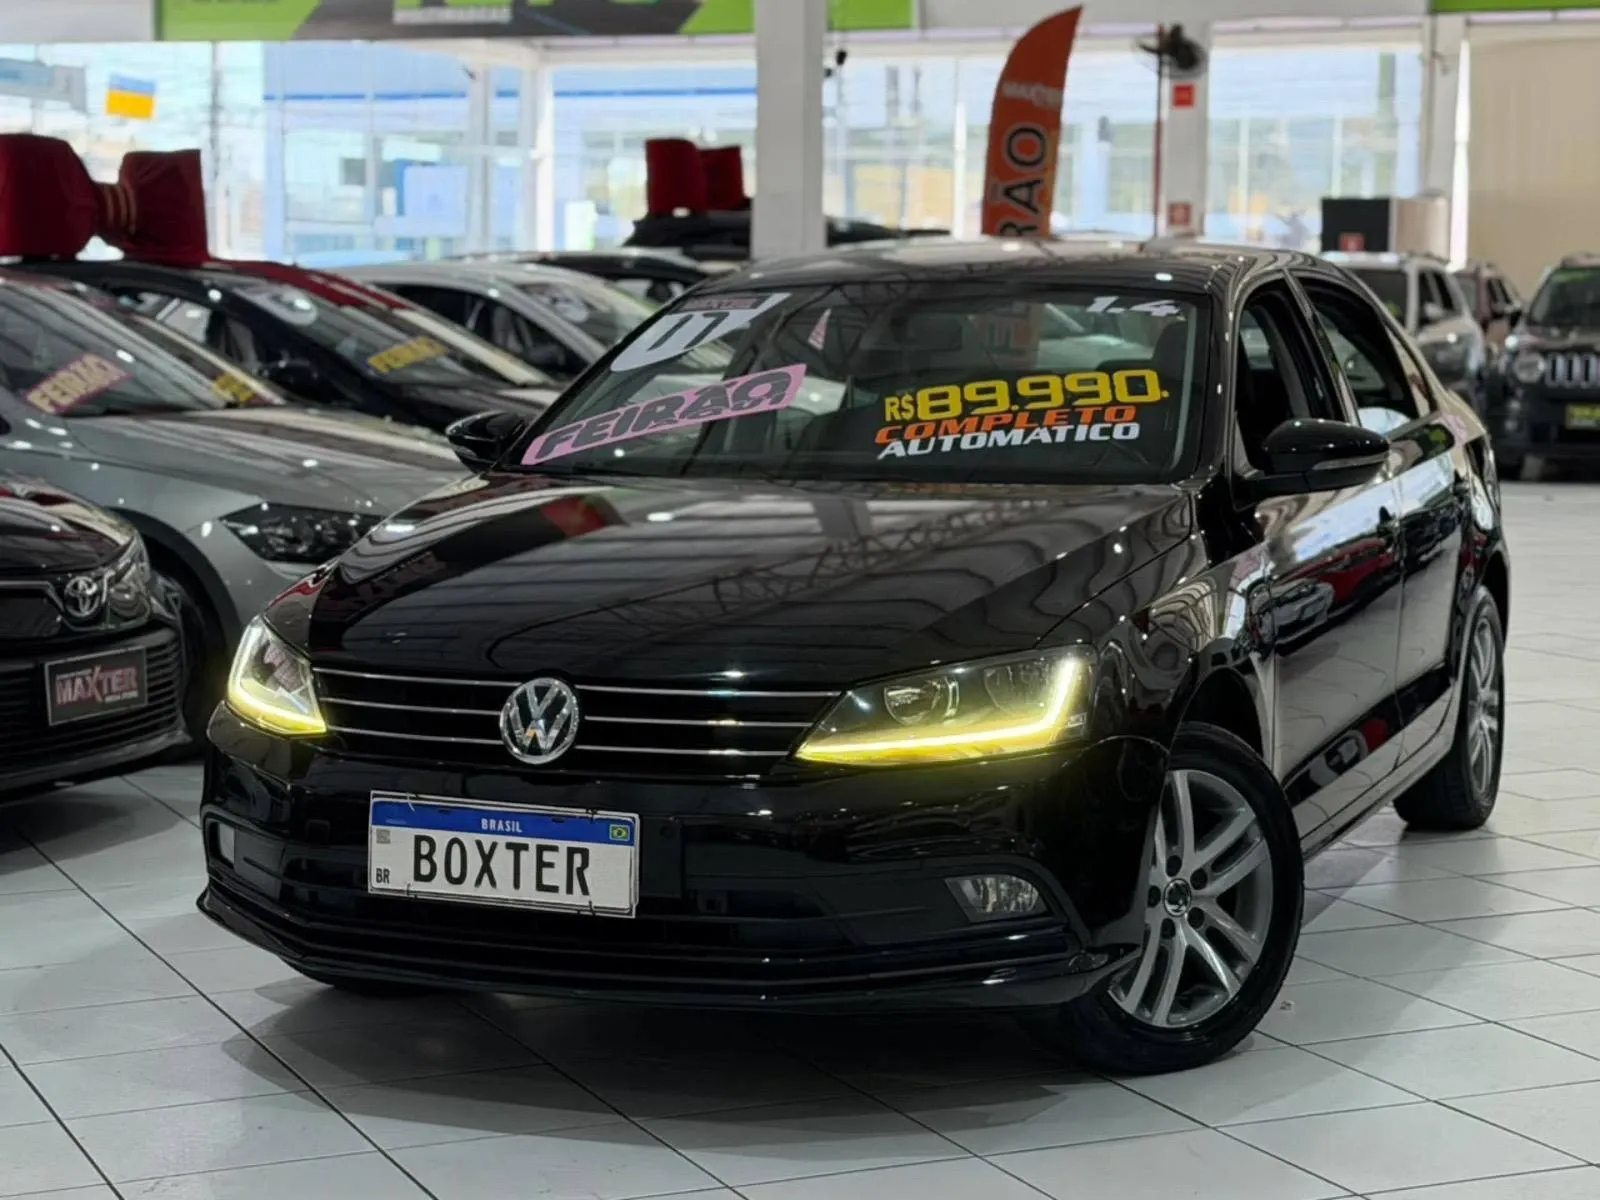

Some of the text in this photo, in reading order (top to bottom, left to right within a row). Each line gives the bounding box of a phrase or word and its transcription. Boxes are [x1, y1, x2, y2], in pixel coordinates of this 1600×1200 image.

[1086, 295, 1181, 318] 1.4
[875, 405, 1136, 444] COMPLETO
[877, 423, 1140, 460] AUTOMATICO
[56, 665, 138, 705] MAXTER
[481, 818, 523, 833] BRASIL
[376, 867, 391, 885] BR
[413, 834, 591, 896] BOXTER
